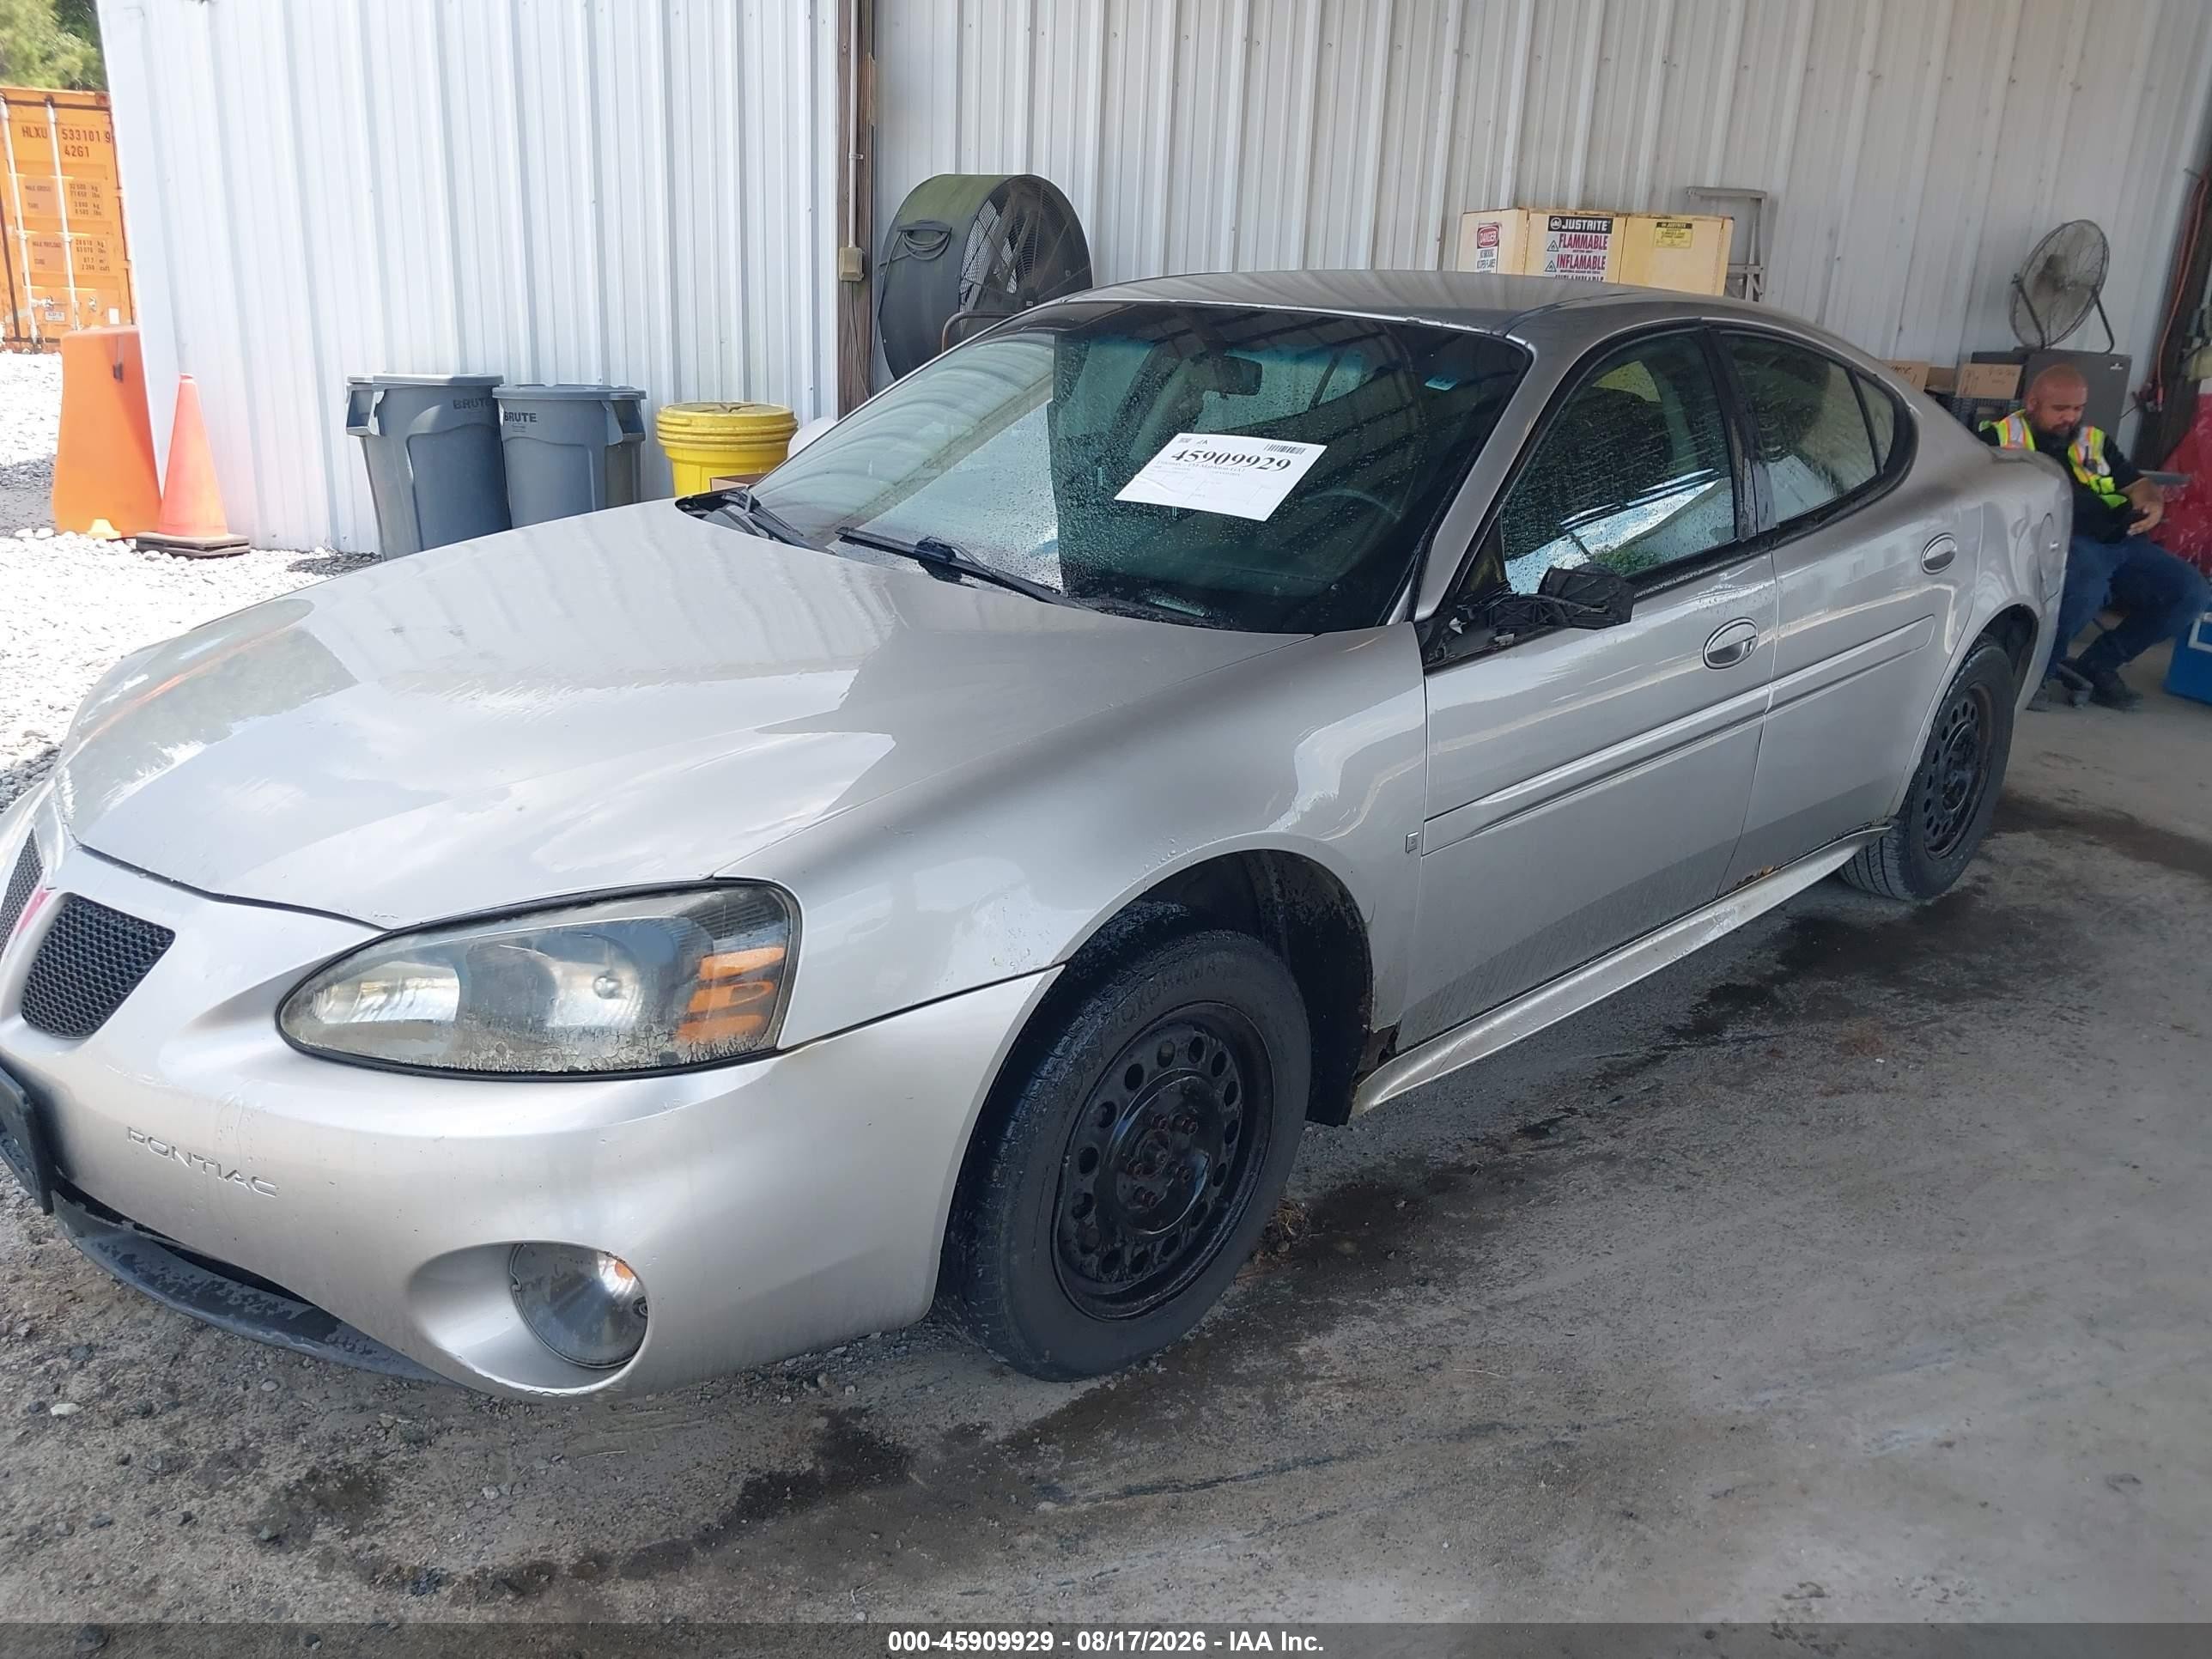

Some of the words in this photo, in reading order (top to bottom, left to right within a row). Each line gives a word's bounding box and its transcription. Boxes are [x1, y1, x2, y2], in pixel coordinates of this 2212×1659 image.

[21, 125, 48, 139] HLXU
[61, 128, 100, 143] 533101
[105, 131, 111, 144] 9
[1562, 219, 1608, 232] JUSTRITE
[1480, 230, 1497, 245] DANGER
[1559, 233, 1608, 251] FLAMMABLE
[1556, 253, 1606, 270] INFLAMABLE
[453, 398, 492, 410] BRUTE
[504, 412, 538, 422] BRUTE
[1171, 448, 1291, 472] 45909929
[127, 1126, 277, 1198] PONTIAC
